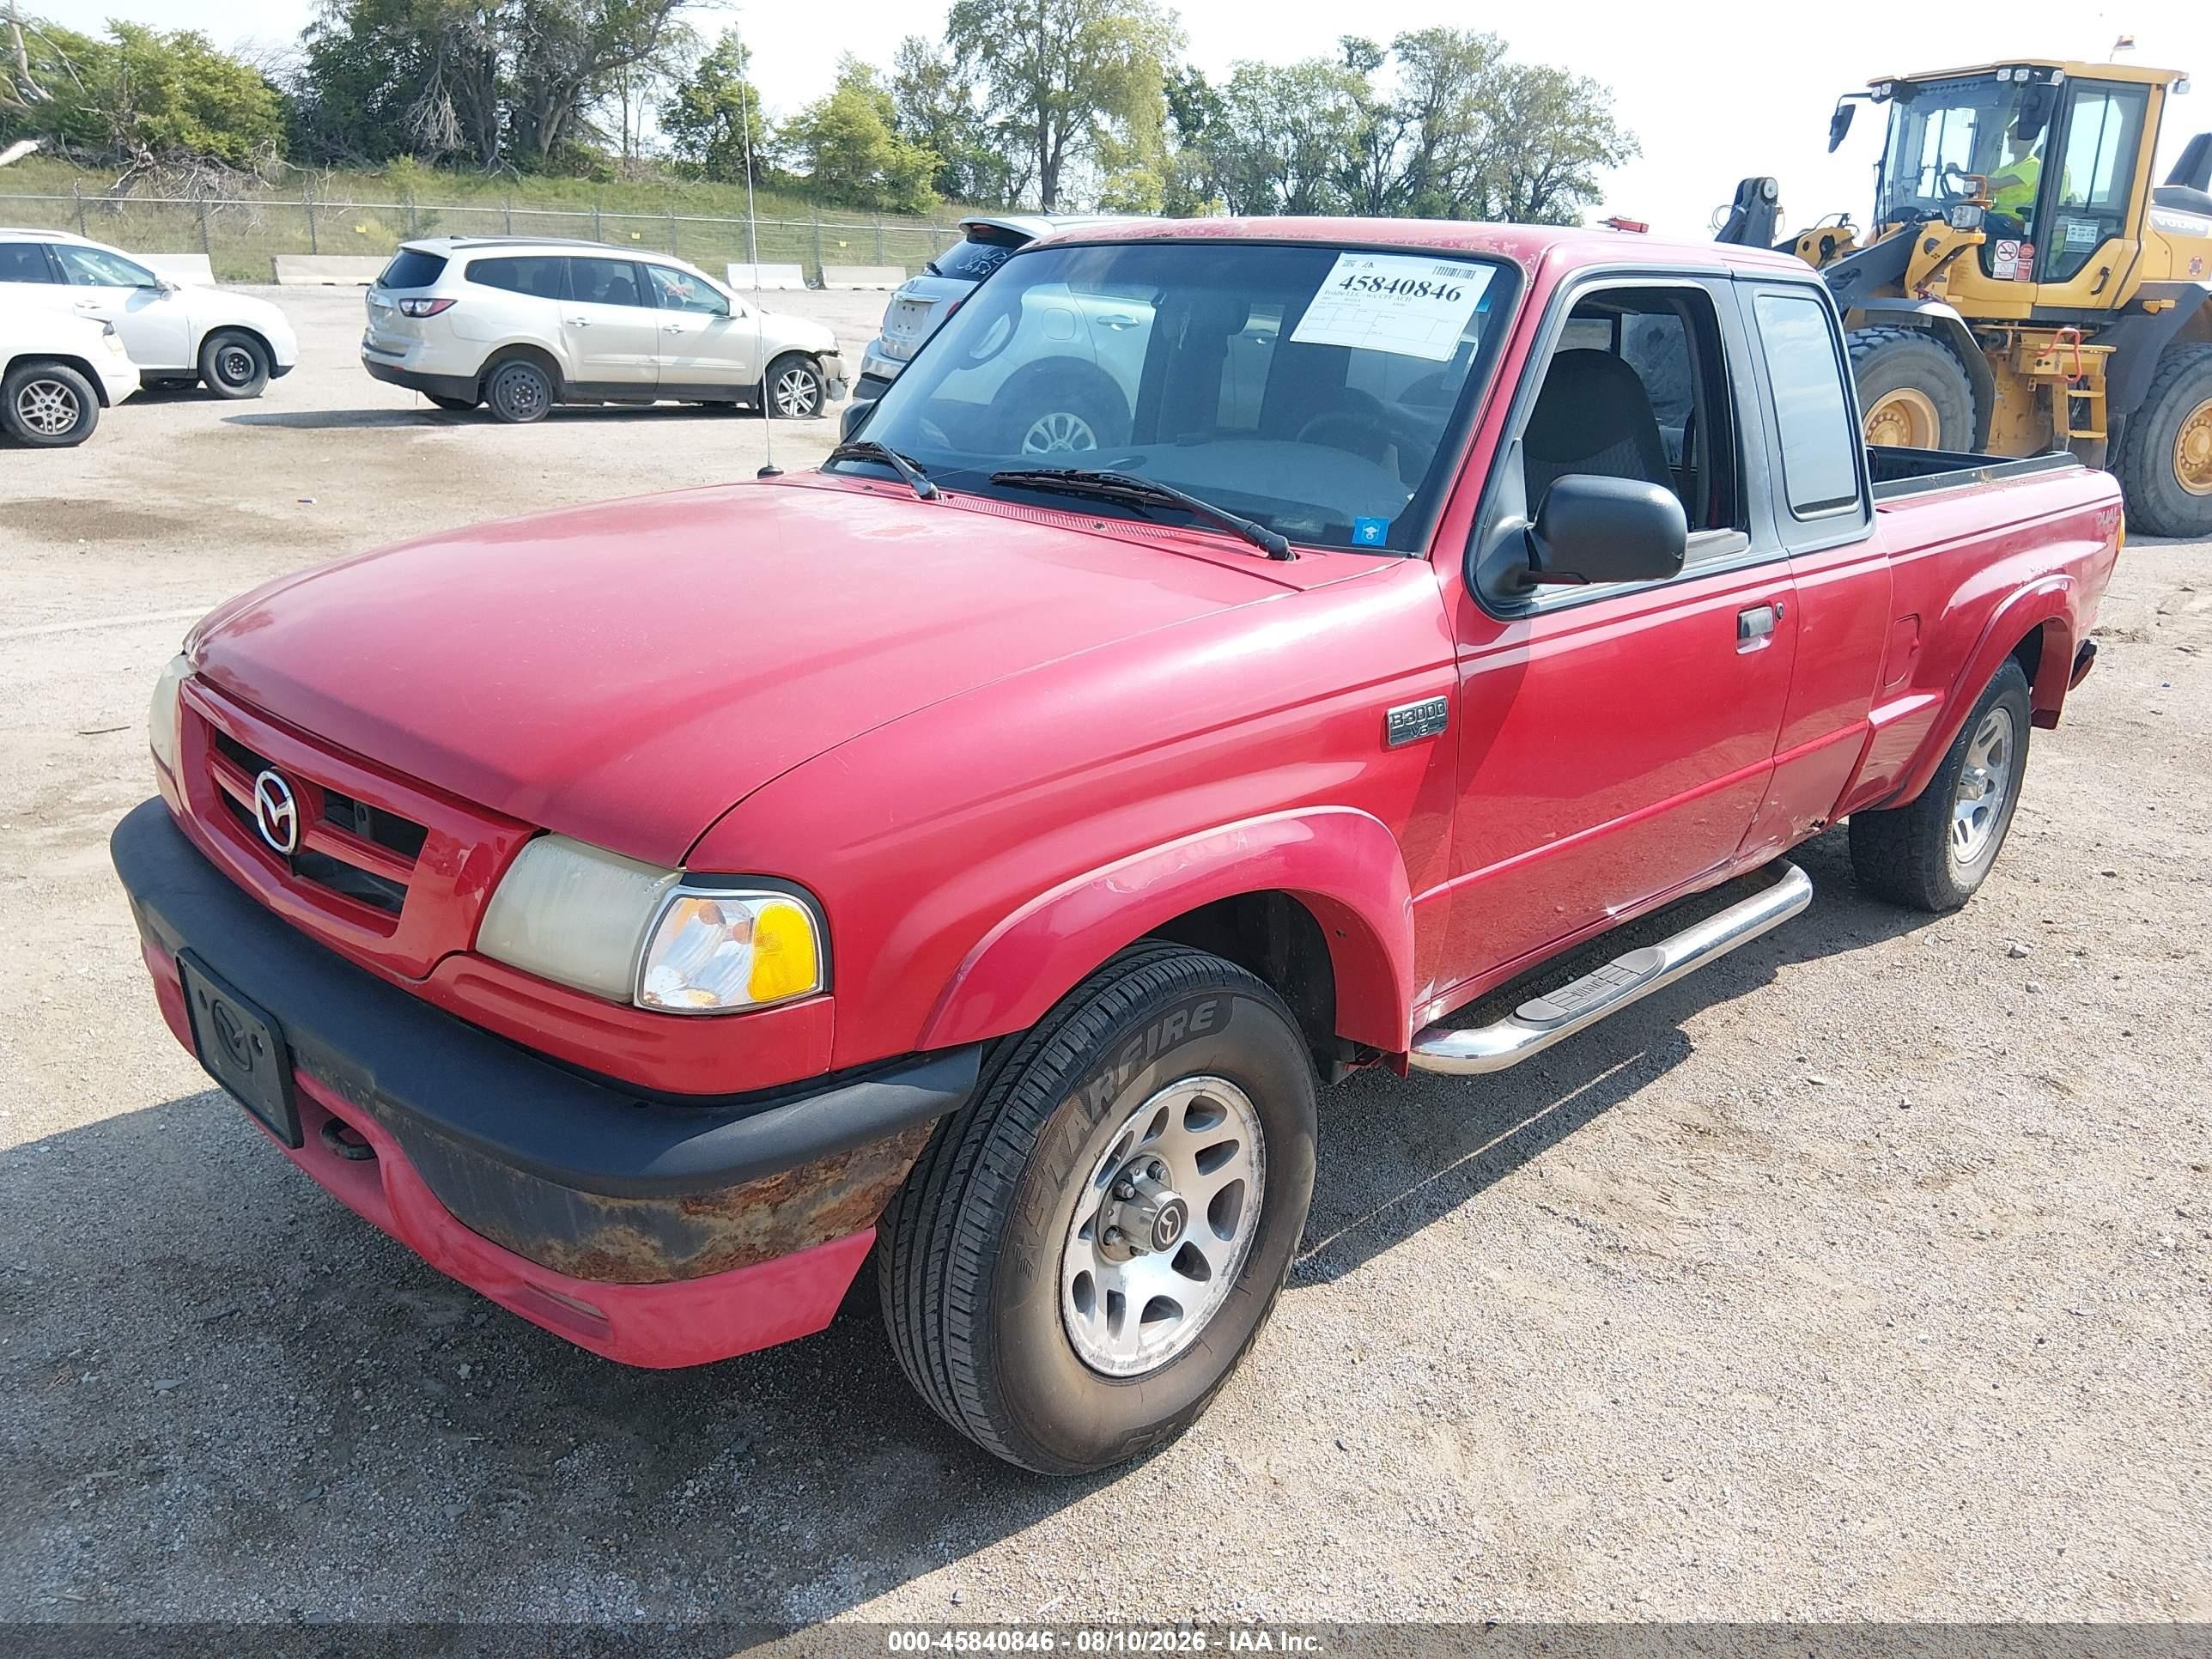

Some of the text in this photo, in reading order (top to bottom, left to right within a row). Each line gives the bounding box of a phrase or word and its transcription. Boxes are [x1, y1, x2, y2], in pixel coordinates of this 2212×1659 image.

[2154, 216, 2206, 232] VOLVO
[1339, 274, 1465, 302] 45840846
[1390, 701, 1446, 730] B3000
[1410, 723, 1429, 738] V6
[1024, 998, 1218, 1239] STARFIRE
